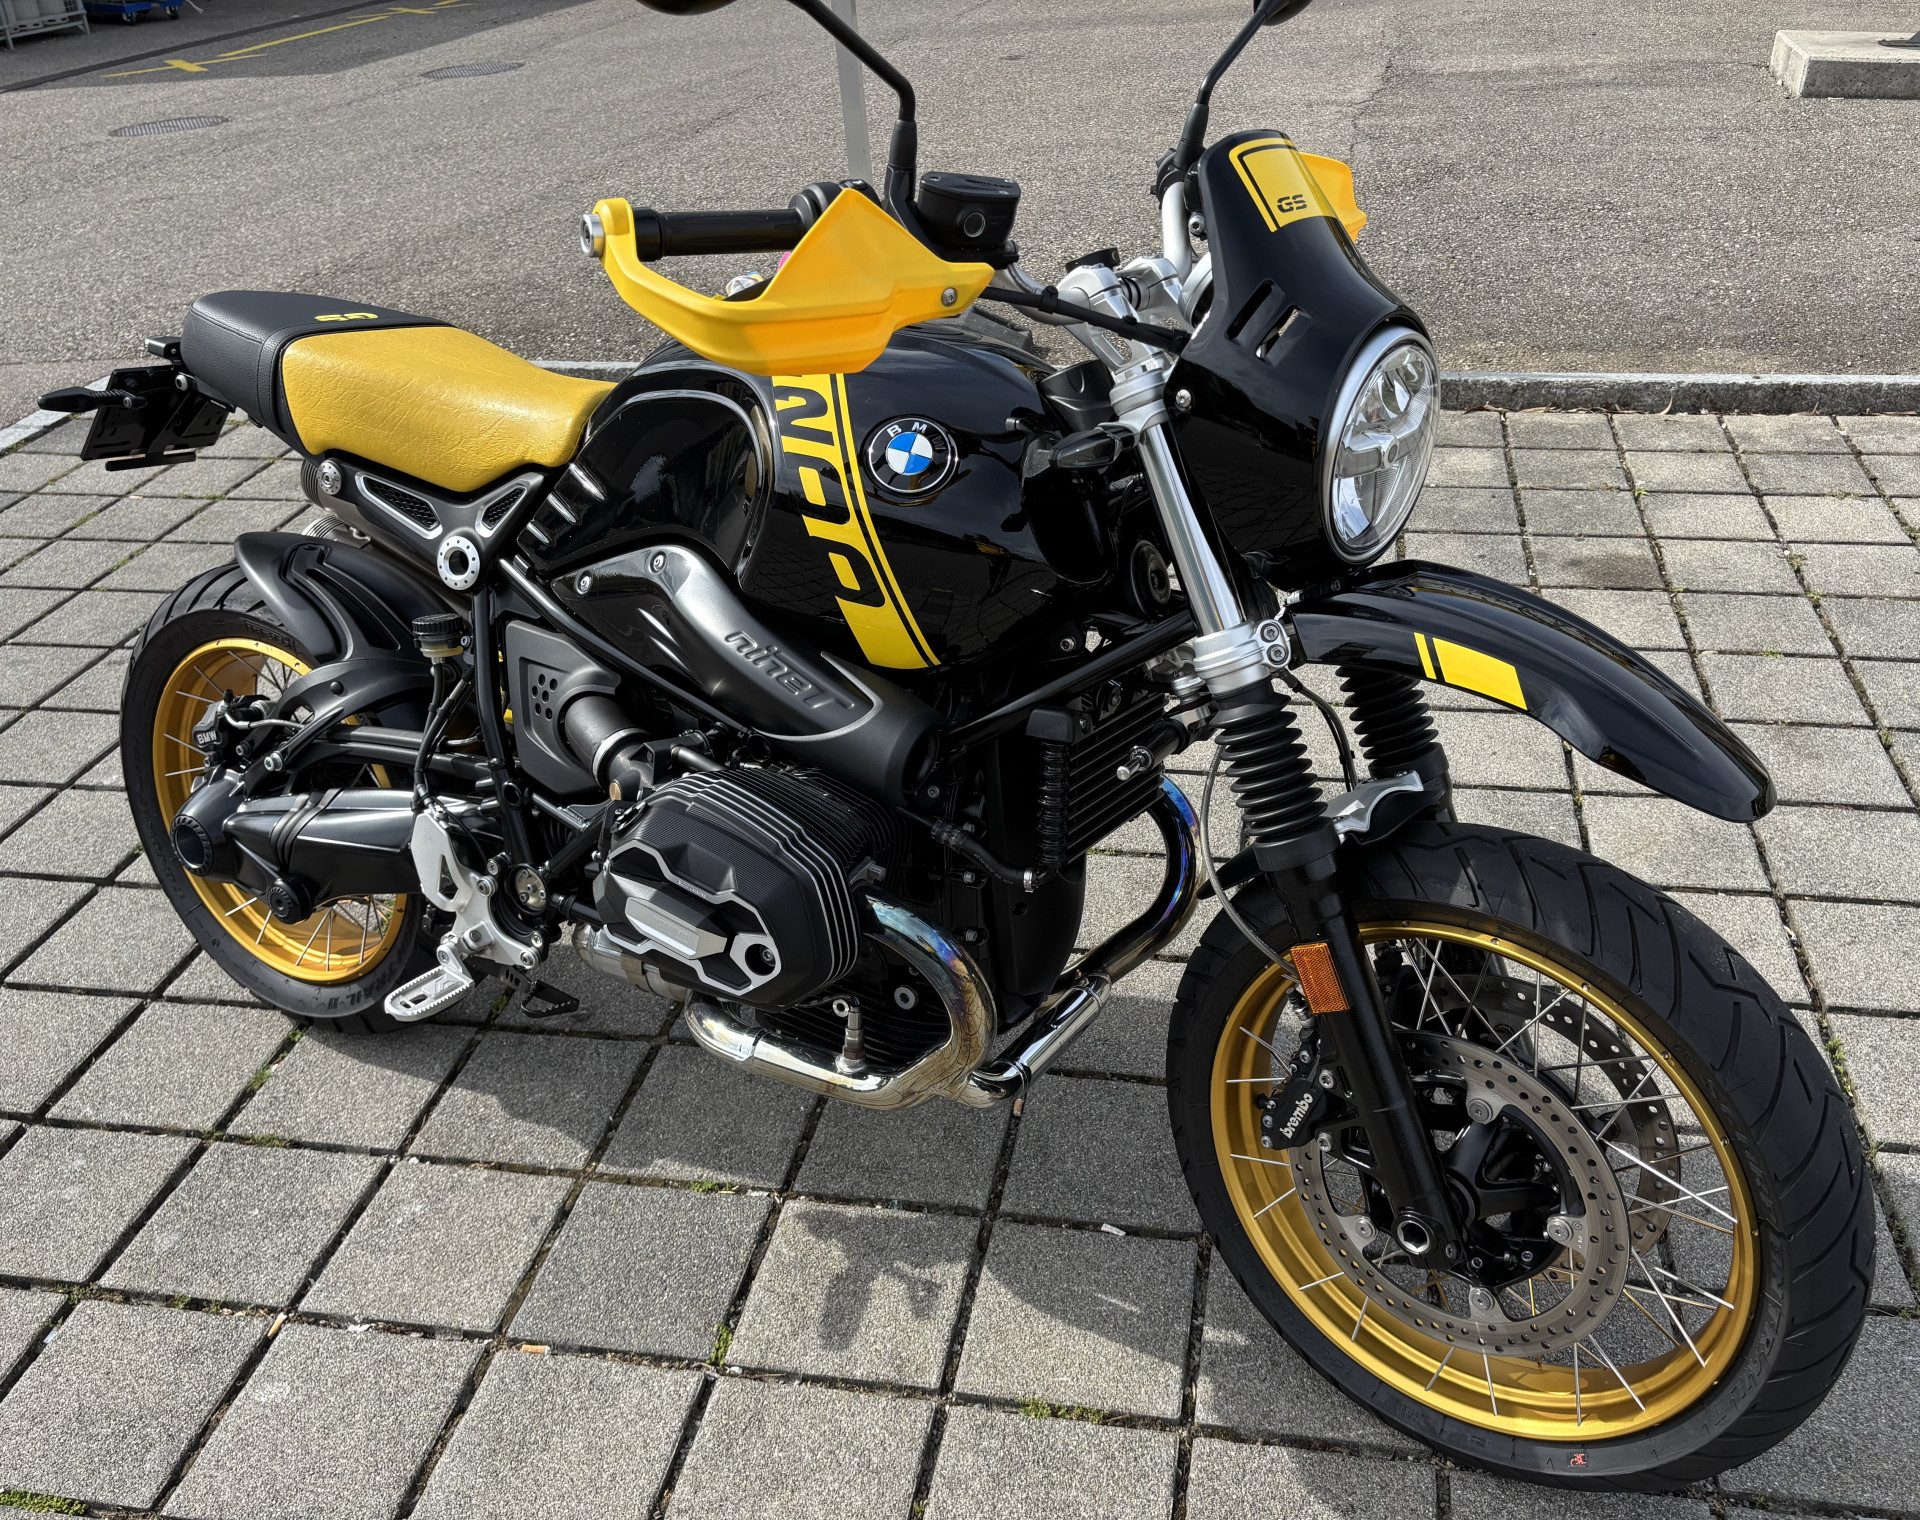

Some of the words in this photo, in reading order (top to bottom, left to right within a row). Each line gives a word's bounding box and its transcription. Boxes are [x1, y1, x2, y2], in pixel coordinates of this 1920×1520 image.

[1277, 194, 1307, 213] GS
[886, 421, 947, 451] BMW
[197, 731, 217, 744] BMW
[1279, 1093, 1313, 1139] brembo
